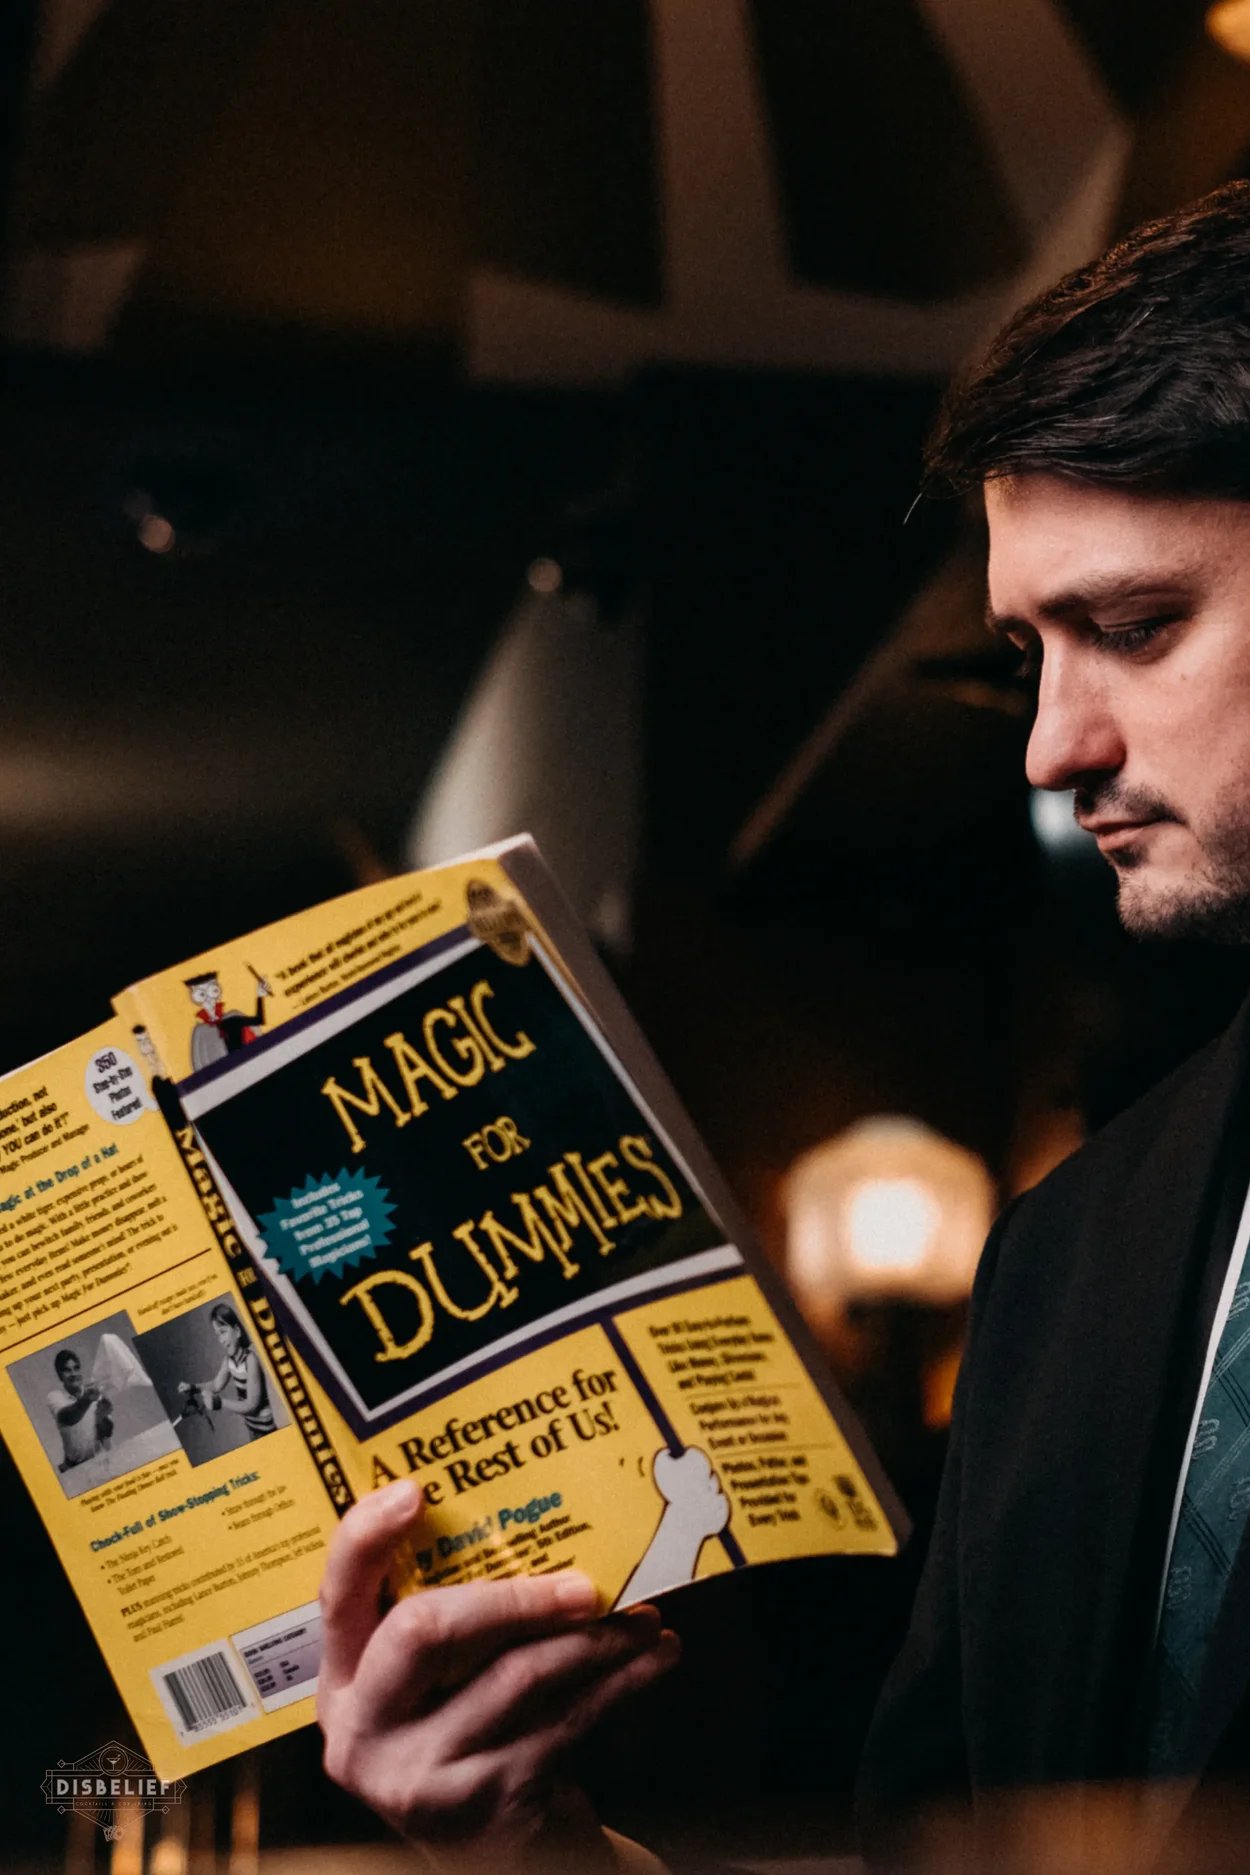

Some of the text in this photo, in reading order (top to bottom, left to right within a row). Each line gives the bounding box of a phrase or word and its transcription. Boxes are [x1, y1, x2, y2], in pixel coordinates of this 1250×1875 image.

[322, 979, 537, 1153] MAGIC
[21, 1102, 57, 1127] but also
[32, 1086, 48, 1102] not
[2, 1138, 22, 1155] YOU
[24, 1131, 40, 1145] can
[19, 1145, 49, 1163] Producer
[50, 1137, 63, 1149] and
[462, 1116, 531, 1171] FOR
[35, 1178, 55, 1193] the
[54, 1165, 80, 1183] Drop
[101, 1144, 119, 1159] Hat
[55, 1185, 89, 1206] expensive
[91, 1187, 118, 1207] practice
[340, 1133, 682, 1362] DUMMIES
[176, 1127, 243, 1259] Magic
[250, 1296, 353, 1511] Dummies
[372, 1369, 619, 1489] A Reference for
[444, 1440, 526, 1495] Rest
[530, 1418, 568, 1458] of
[566, 1402, 621, 1441] Us!
[89, 1521, 144, 1553] Chock-Full
[157, 1484, 230, 1522] Show-Stopping
[498, 1492, 562, 1530] Pogue
[120, 1602, 143, 1617] PLUS
